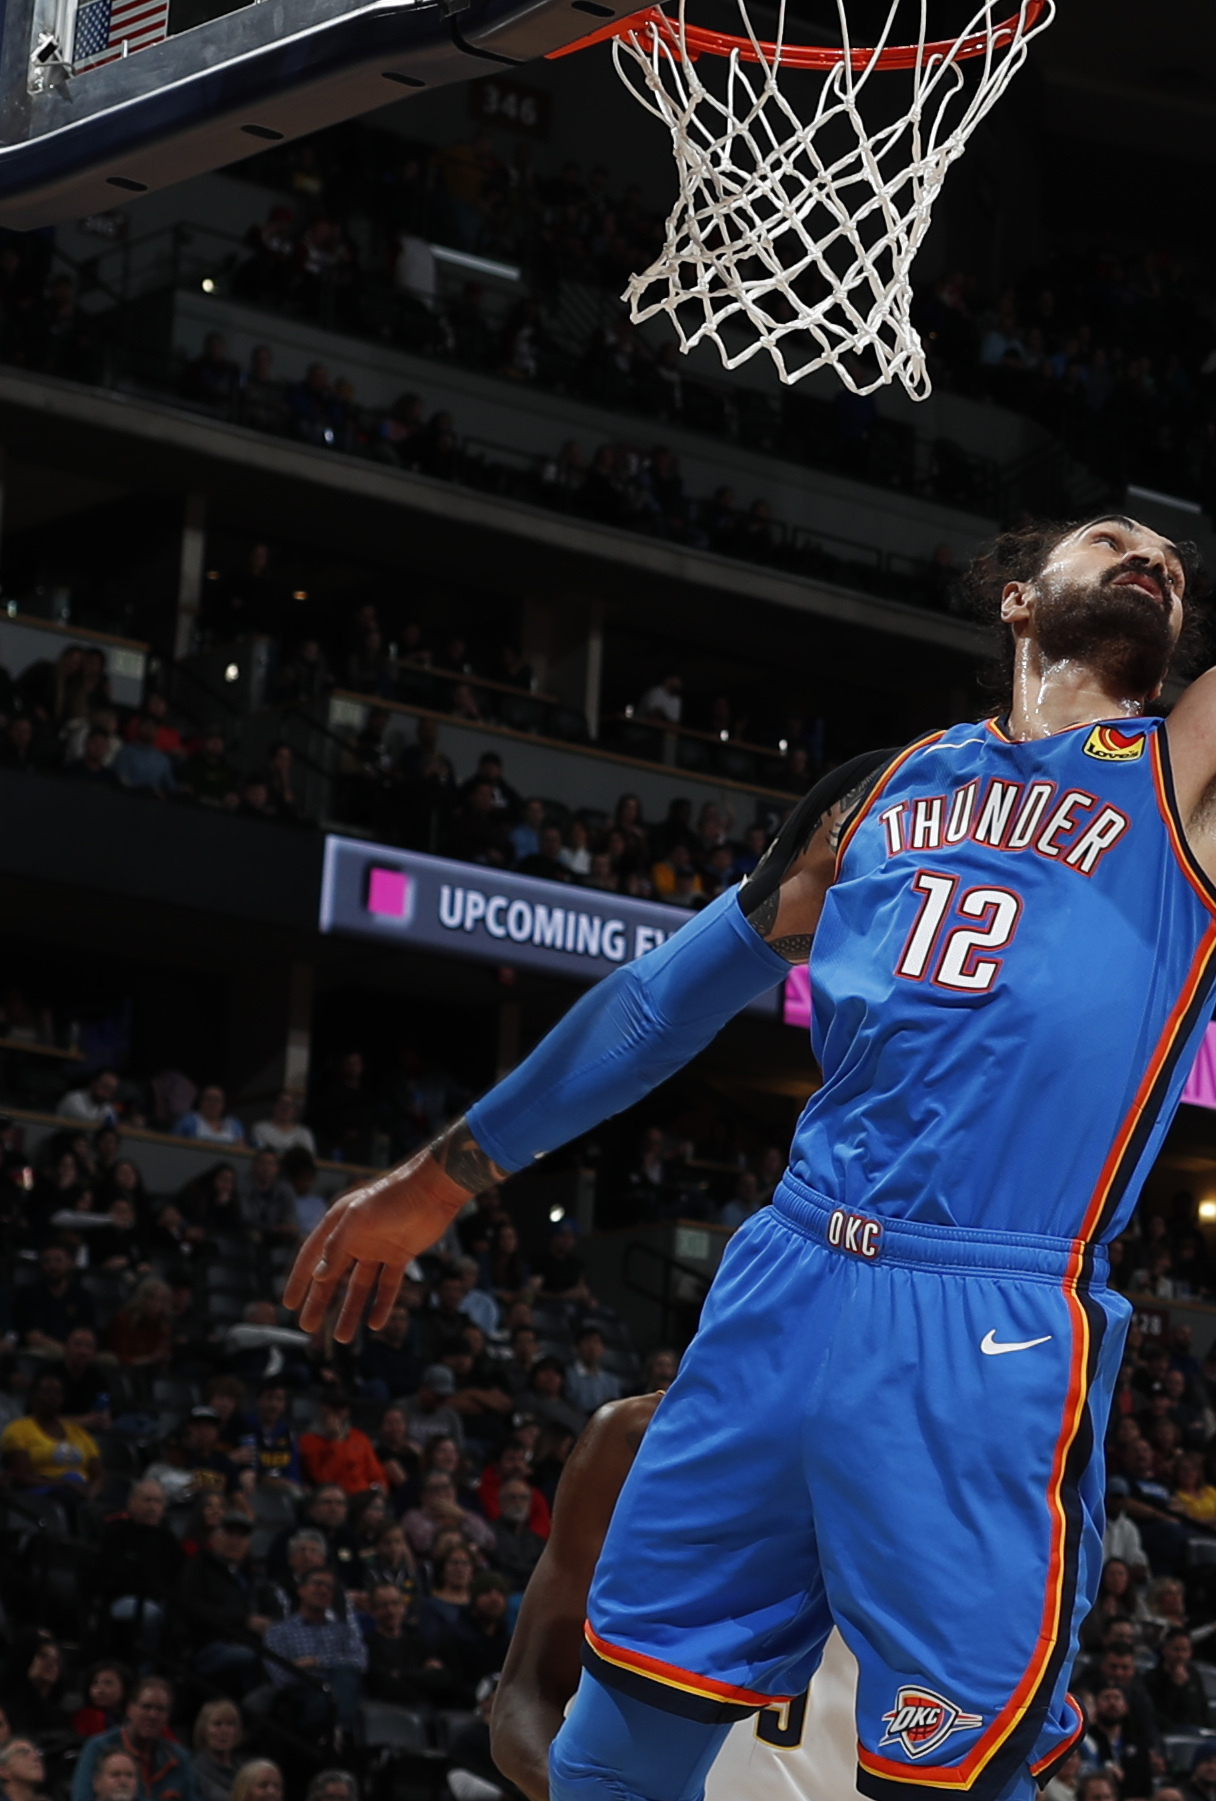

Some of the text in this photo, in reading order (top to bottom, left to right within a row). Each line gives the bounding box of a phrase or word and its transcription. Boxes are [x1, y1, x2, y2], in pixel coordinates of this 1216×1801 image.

[483, 84, 538, 127] 346
[878, 777, 1132, 878] THUNDER
[439, 884, 627, 962] UPCOMING
[893, 868, 1024, 993] 12
[828, 1207, 884, 1260] OKC
[889, 1705, 941, 1734] OKC
